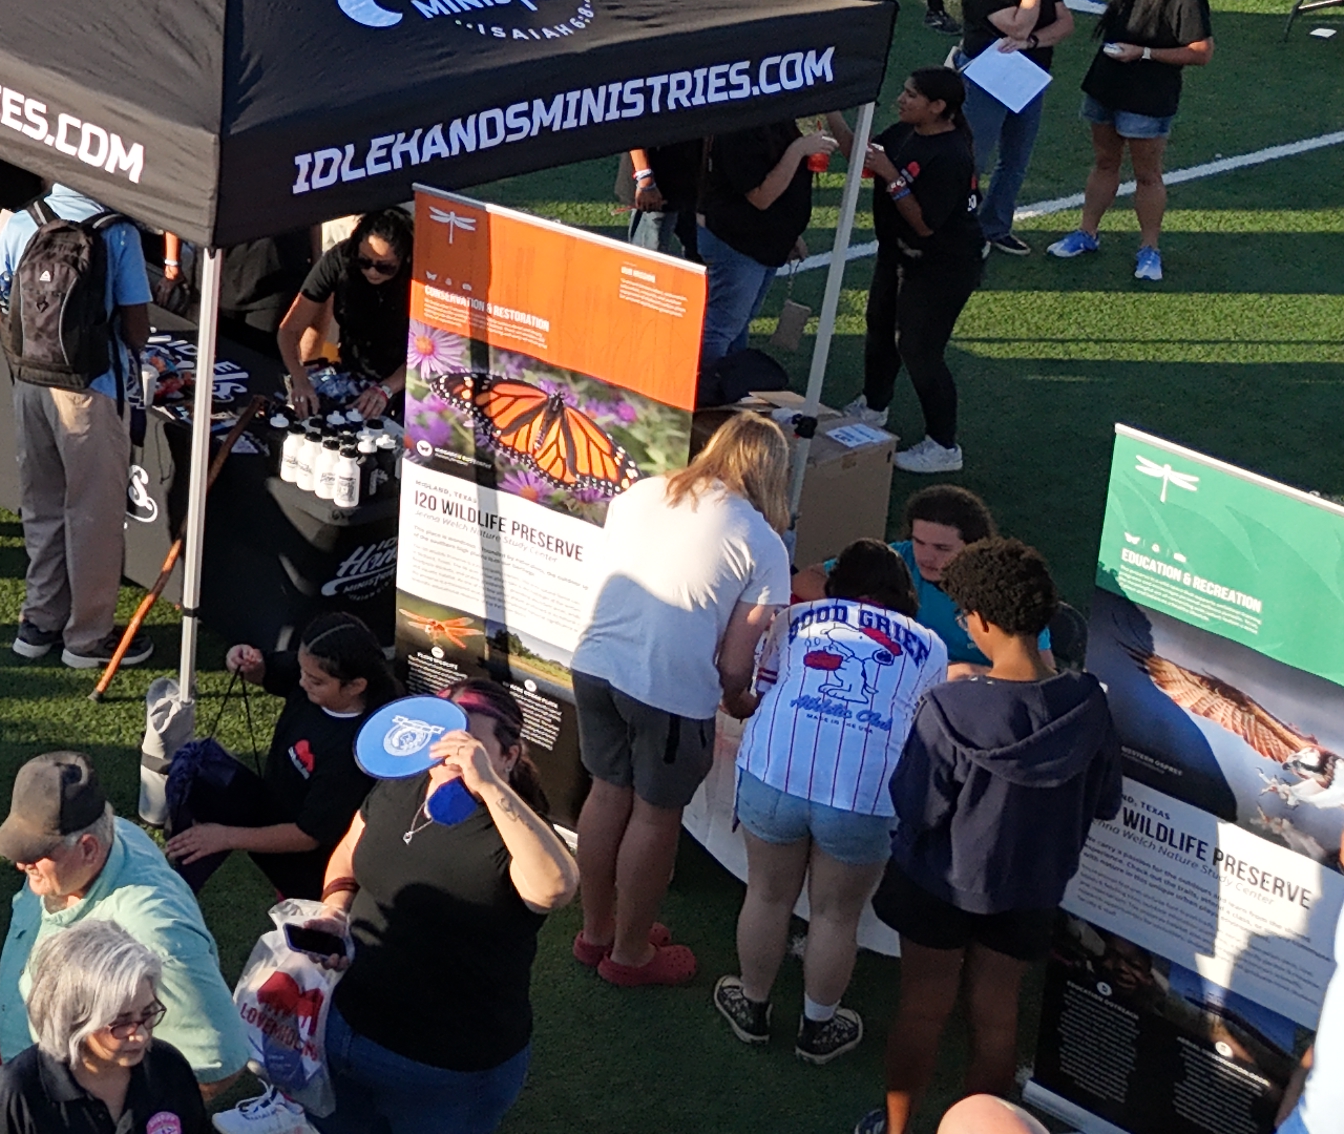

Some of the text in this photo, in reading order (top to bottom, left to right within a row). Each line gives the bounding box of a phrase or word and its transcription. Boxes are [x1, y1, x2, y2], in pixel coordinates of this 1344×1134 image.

[476, 21, 573, 43] ISAIAH
[291, 45, 837, 196] IDLEHANDSMINISTRIES.COM
[424, 284, 485, 310] CONSERVATION
[493, 304, 550, 333] RESTORATION
[415, 479, 478, 504] MIDLAND, TEXAS
[414, 509, 440, 524] Jenna
[441, 518, 469, 533] Welch
[470, 525, 502, 543] Nature
[503, 535, 529, 554] Study
[441, 497, 508, 533] WILDLIFE
[511, 520, 585, 563] PRESERVE
[336, 542, 397, 578] Han
[1120, 548, 1183, 584] EDUCATION
[1182, 572, 1192, 587] &
[1192, 574, 1263, 614] RECREATION
[857, 608, 932, 668] GRIEF
[1139, 801, 1171, 821] TEXAS
[1092, 819, 1275, 906] enna Welch Nature Study Center
[1099, 858, 1126, 875] nature
[1134, 874, 1148, 887] this
[1148, 881, 1175, 898] unique
[1122, 806, 1313, 911] WILDLIFE PRESERVE
[1126, 861, 1149, 877] Check
[1149, 872, 1163, 884] out
[1163, 879, 1177, 890] the
[1152, 863, 1164, 875] for
[1164, 870, 1178, 881] the
[1177, 877, 1213, 897] outdoors
